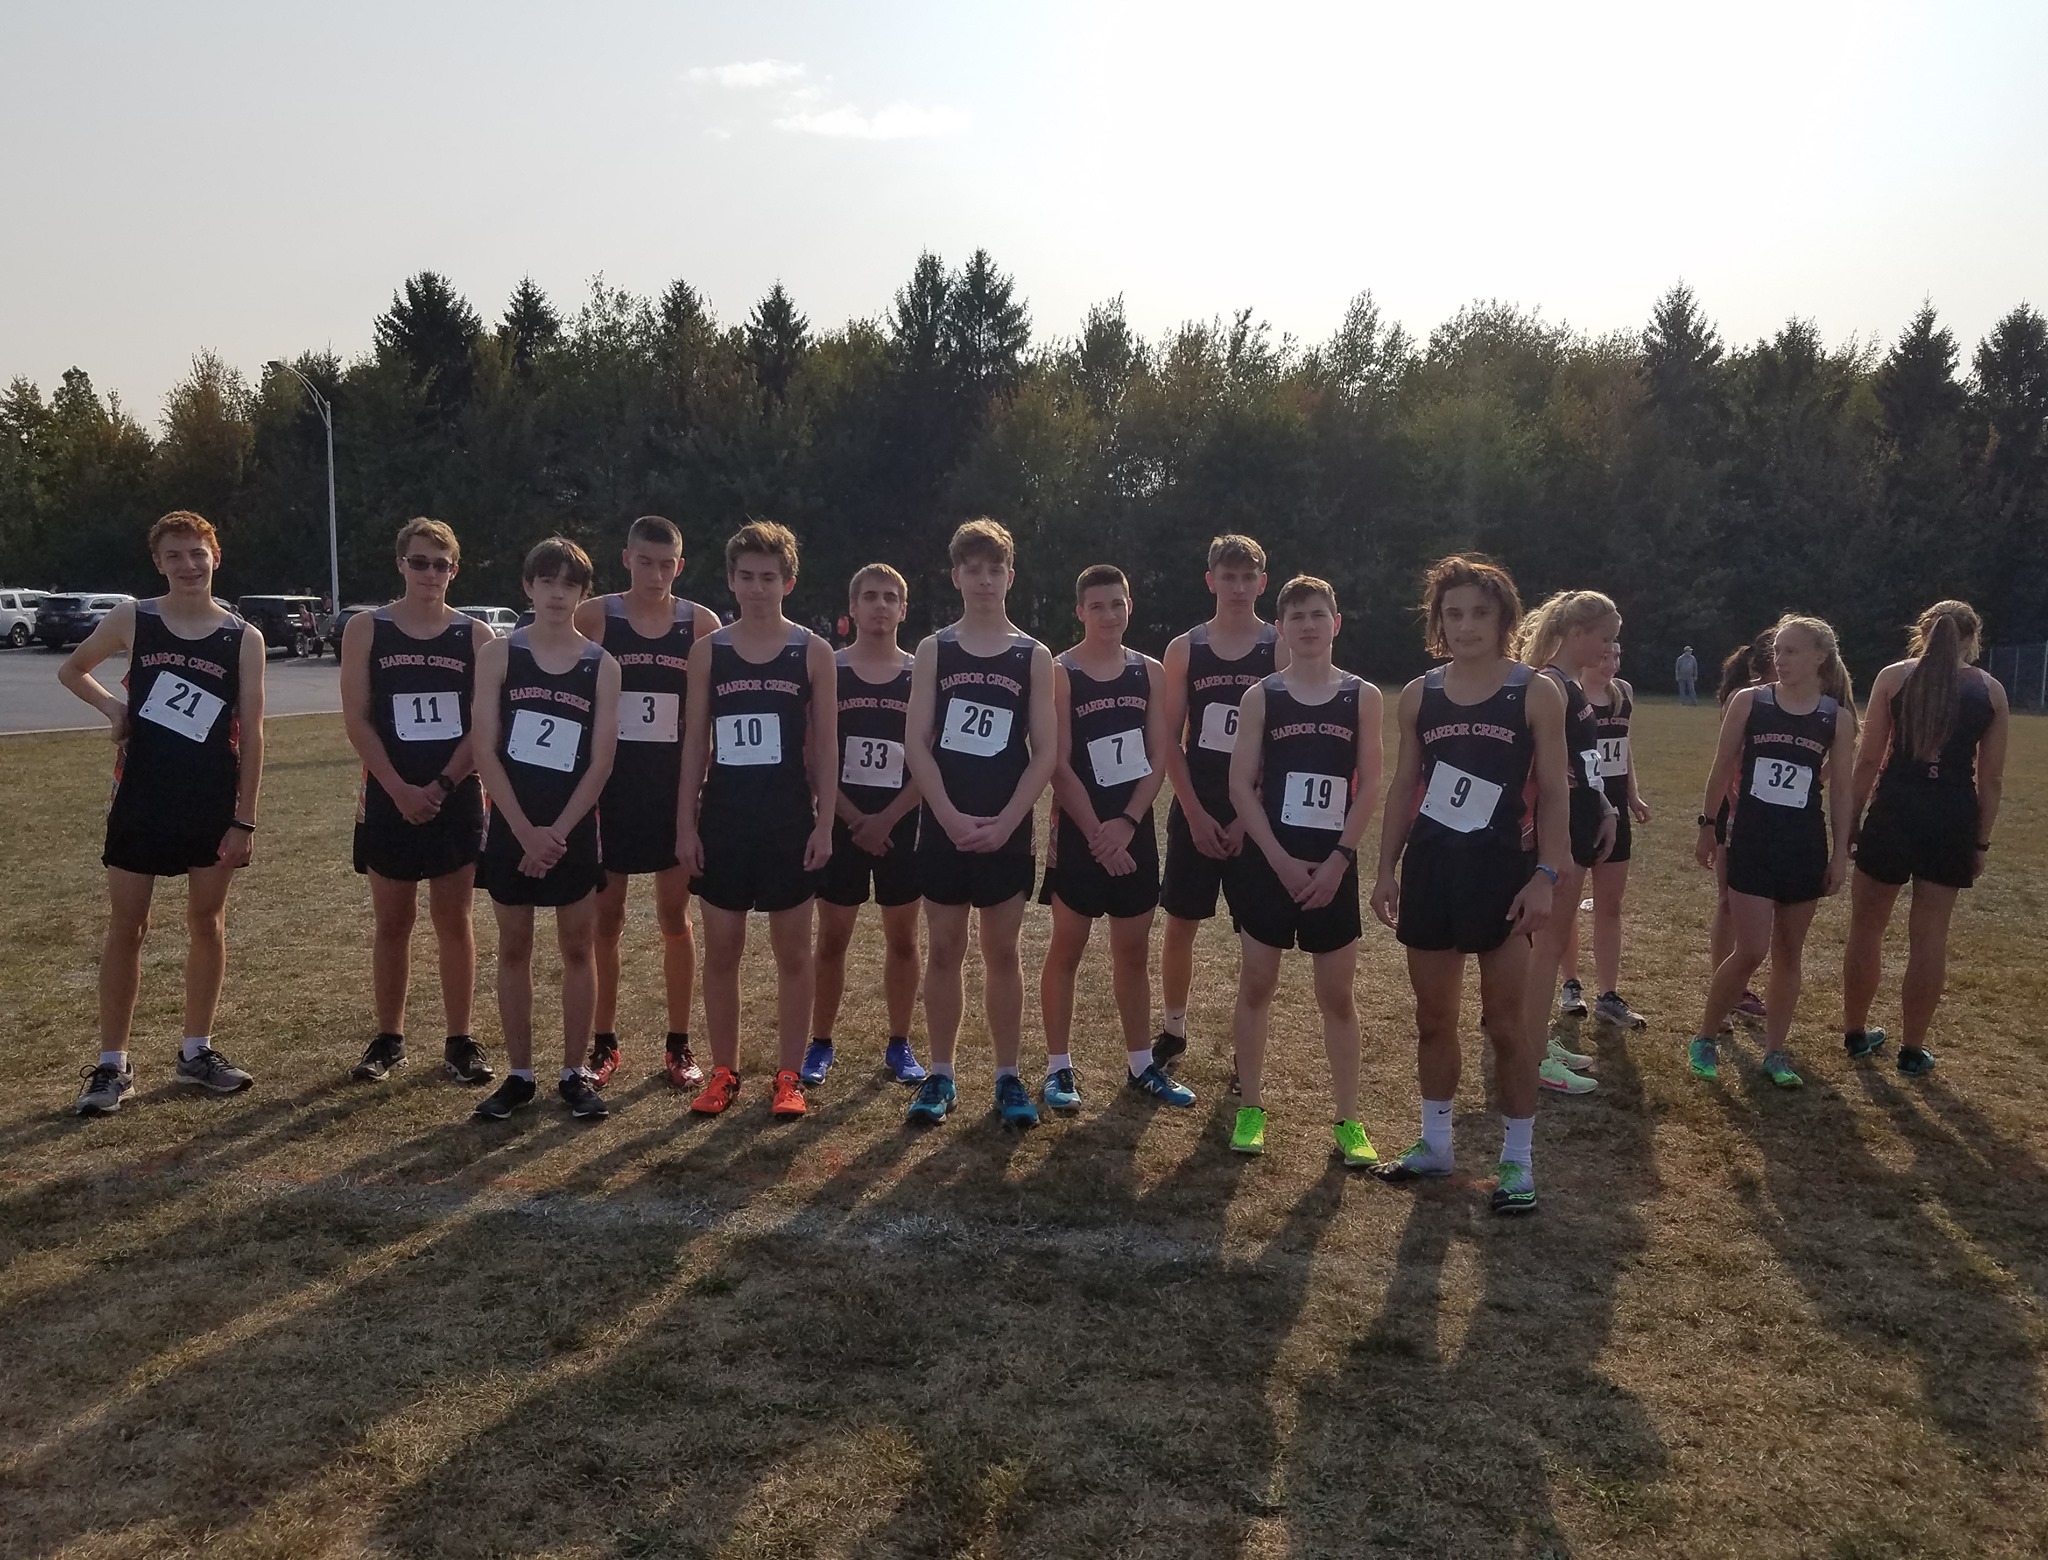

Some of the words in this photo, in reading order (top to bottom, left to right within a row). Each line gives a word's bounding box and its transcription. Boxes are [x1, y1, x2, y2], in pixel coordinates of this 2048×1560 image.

[140, 652, 186, 668] HARBOR
[188, 657, 228, 680] CREEK
[379, 654, 426, 670] HARBOR
[427, 655, 467, 673] CREEK
[614, 653, 654, 666] ARBOR
[716, 679, 763, 696] HARBOR
[764, 679, 801, 696] CREEK
[940, 672, 985, 691] HARBOR
[986, 673, 1022, 696] CREEK
[1193, 675, 1234, 691] HARBOR
[165, 682, 203, 719] 21
[412, 696, 442, 724] 11
[509, 686, 553, 701] HARBOR
[554, 691, 591, 712] CREEK
[642, 696, 656, 724] 3
[880, 698, 909, 713] CREE
[1075, 697, 1116, 718] HARBOR
[535, 718, 556, 749] 2
[733, 717, 763, 747] 10
[960, 705, 995, 738] 26
[1224, 708, 1239, 736] 6
[1270, 722, 1317, 741] HARBOR
[1318, 722, 1354, 742] CREEK
[1423, 723, 1470, 745] HARBOR
[1472, 723, 1516, 744] CREEK
[860, 740, 888, 770] 33
[1111, 737, 1124, 765] 7
[1602, 741, 1621, 763] 14
[1753, 733, 1794, 745] HARBOR
[1795, 736, 1825, 754] CREEK
[1768, 762, 1798, 790] 32
[1302, 777, 1332, 809] 19
[1450, 776, 1472, 809] 9
